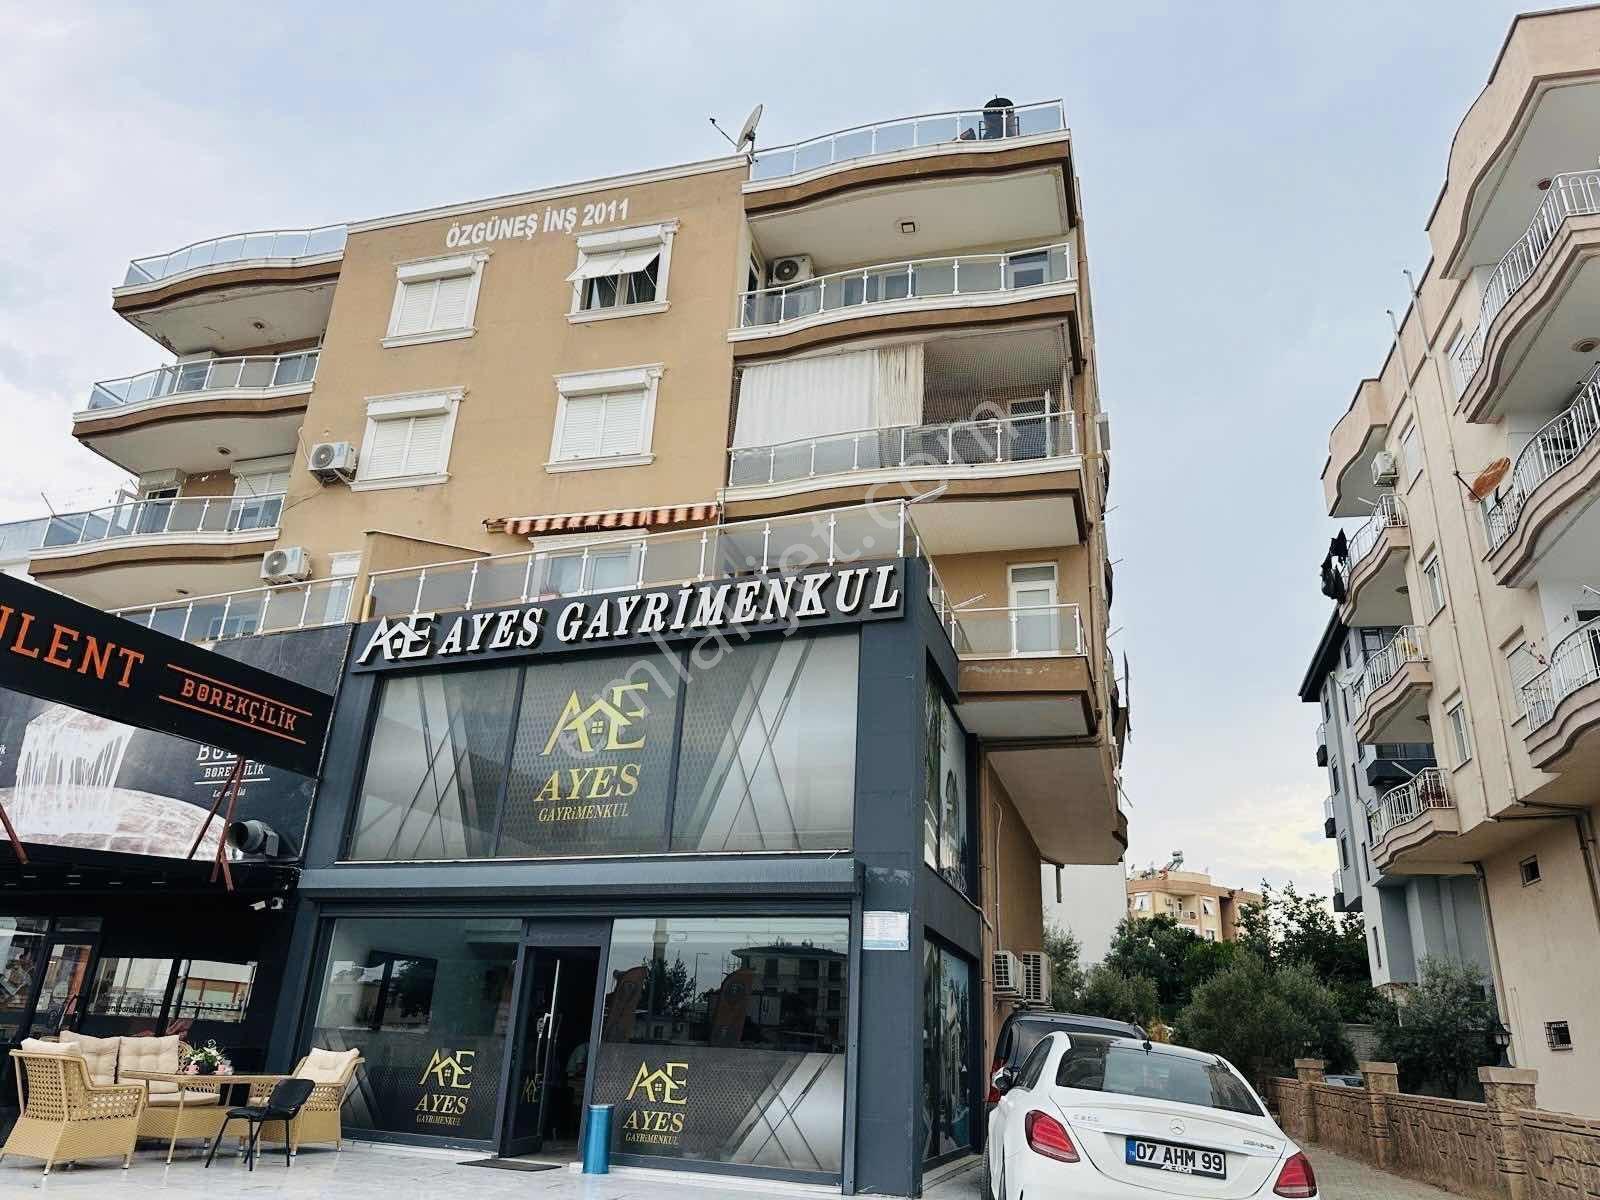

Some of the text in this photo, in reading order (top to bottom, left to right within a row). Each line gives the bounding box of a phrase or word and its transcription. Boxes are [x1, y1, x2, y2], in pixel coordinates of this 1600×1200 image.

[445, 198, 629, 248] ÖZGÜNEŞ İNŞ 2011
[437, 607, 543, 655] AYES
[556, 565, 899, 643] GAYRİMENKUL
[534, 763, 641, 802] AYES
[415, 1093, 469, 1115] AYES
[622, 1110, 686, 1133] AYES
[1136, 1143, 1157, 1160] 07
[1163, 1146, 1196, 1167] AHM
[1201, 1152, 1223, 1171] 99
